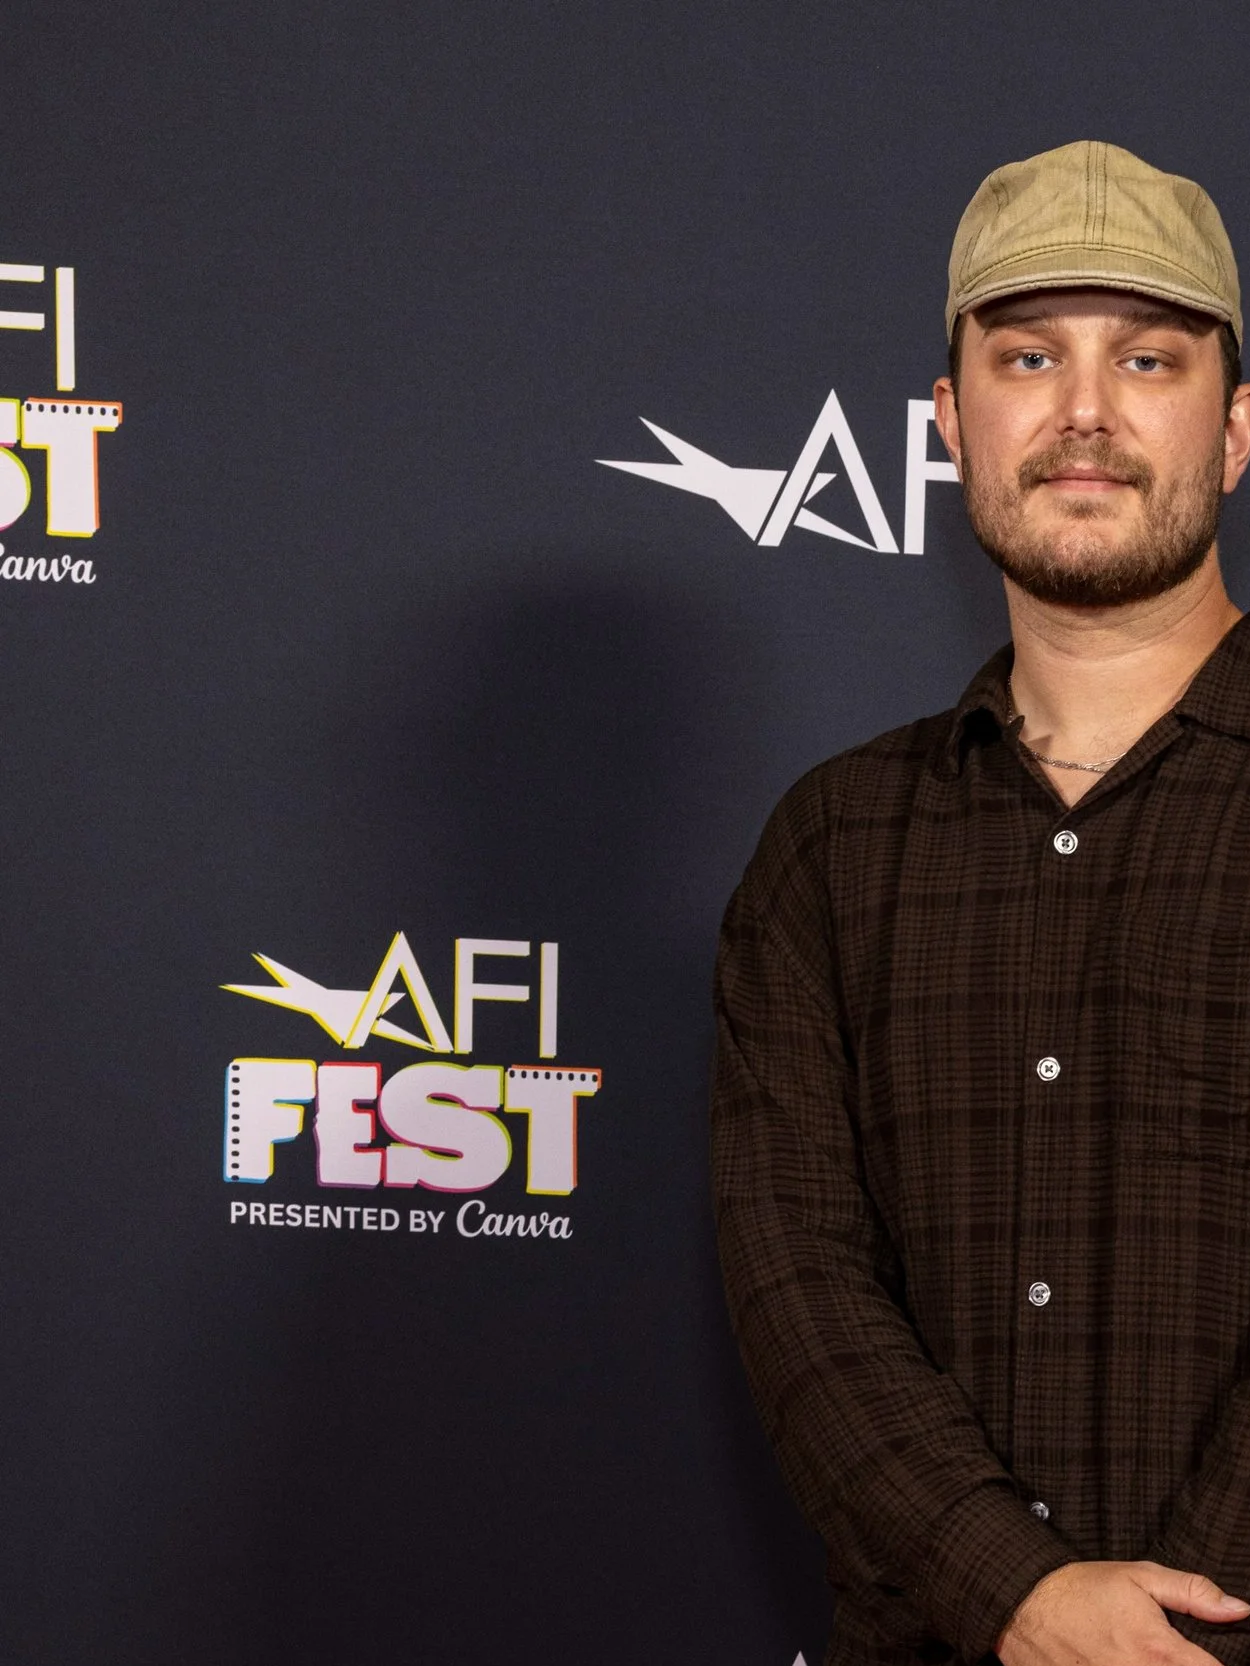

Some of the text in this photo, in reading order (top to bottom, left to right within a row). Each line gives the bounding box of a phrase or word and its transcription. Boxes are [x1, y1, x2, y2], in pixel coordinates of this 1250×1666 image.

[0, 542, 96, 584] anva
[342, 930, 558, 1059] AFI
[223, 1057, 602, 1196] FEST
[231, 1199, 573, 1239] PRESENTED BY Canva
